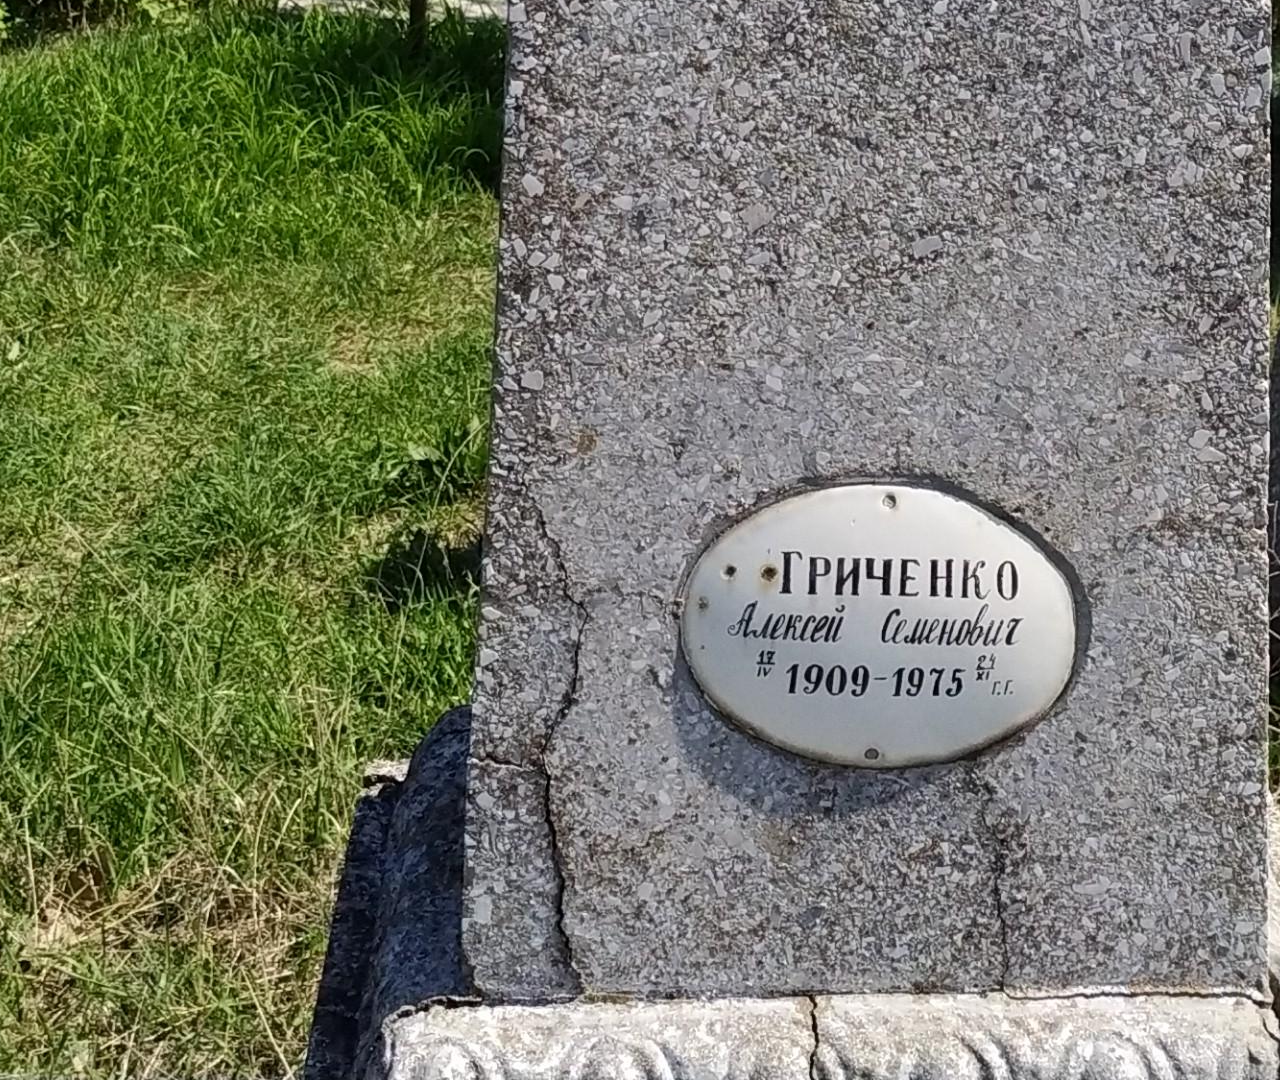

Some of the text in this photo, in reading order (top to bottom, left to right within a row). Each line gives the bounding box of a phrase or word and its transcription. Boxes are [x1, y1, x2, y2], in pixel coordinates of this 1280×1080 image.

[779, 550, 1020, 600] ГРИЧЕНКО
[726, 600, 1025, 648] Алексей Семенович
[786, 663, 966, 698] 1909-1975
